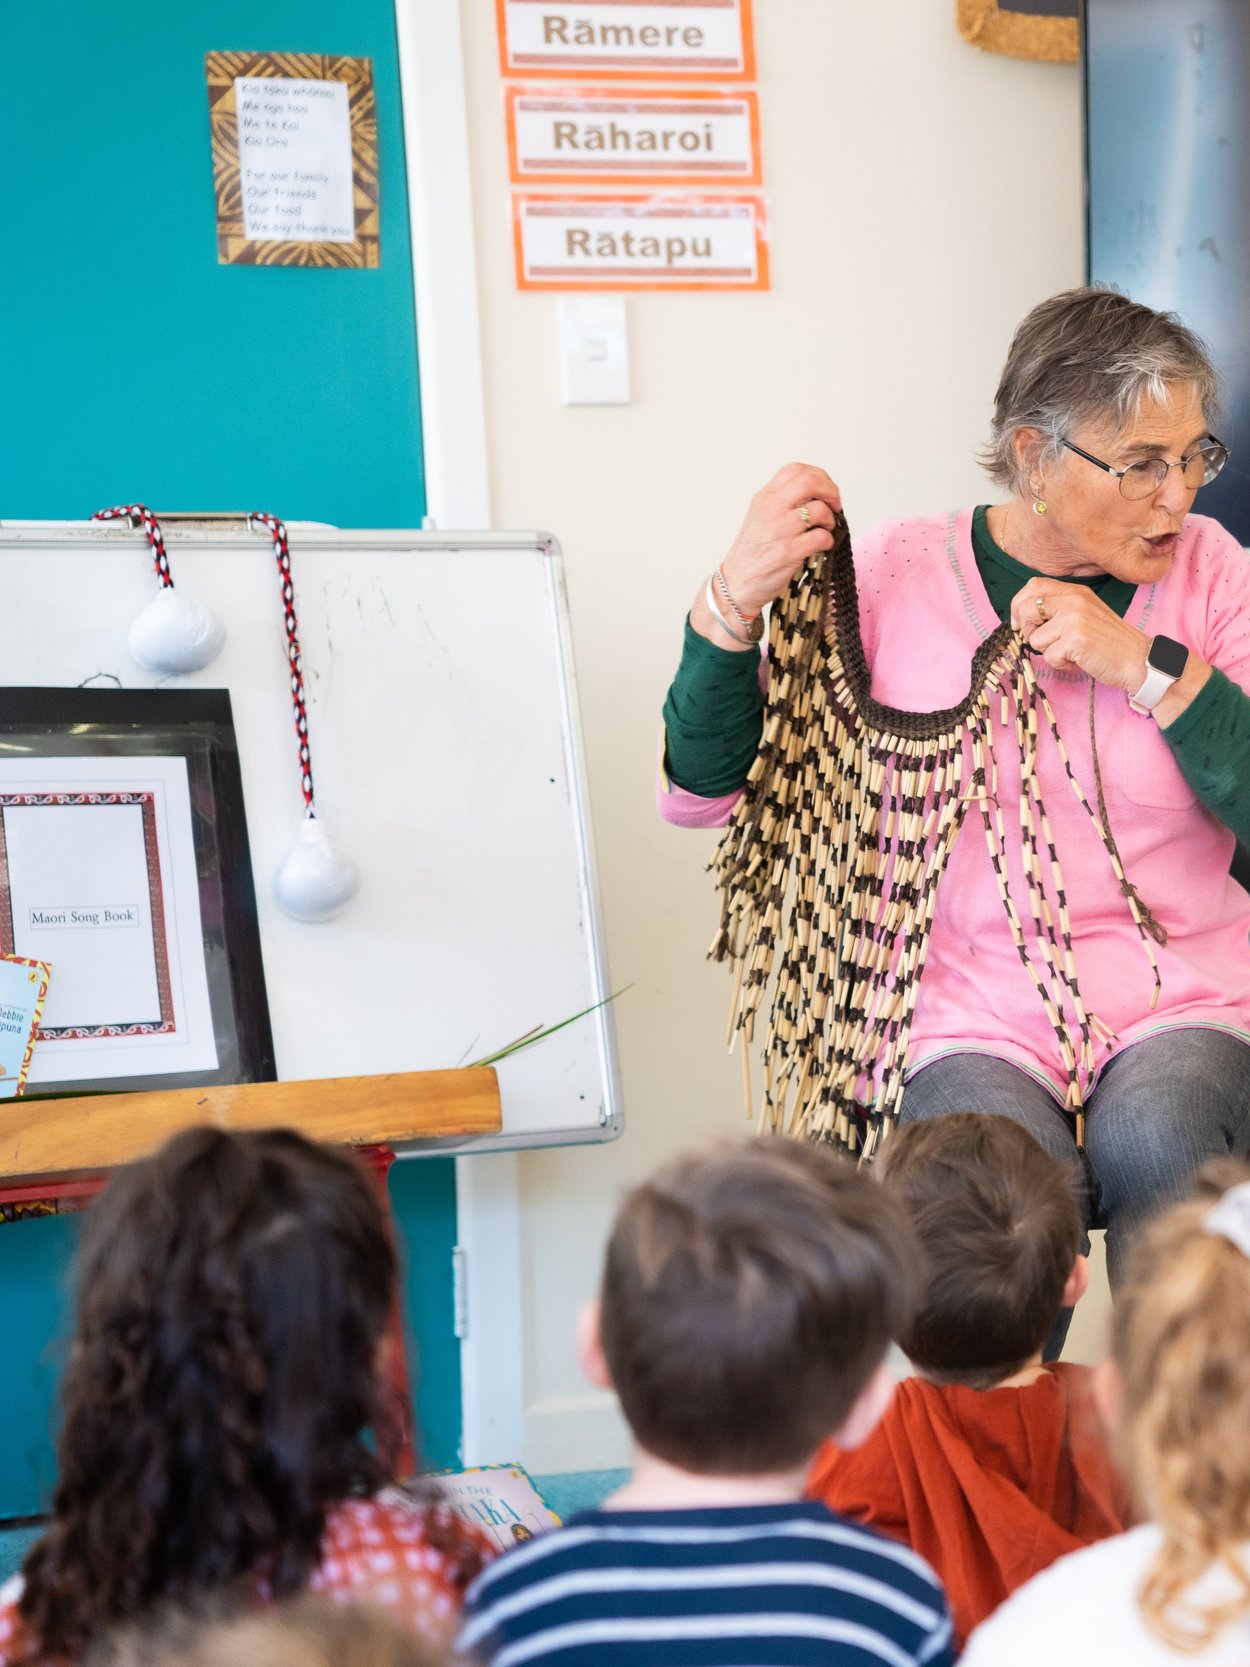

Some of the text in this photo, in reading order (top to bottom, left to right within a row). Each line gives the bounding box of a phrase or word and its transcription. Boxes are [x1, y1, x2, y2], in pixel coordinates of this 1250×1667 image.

[542, 14, 704, 48] Rāmere
[552, 120, 714, 152] Rāharoi
[565, 228, 713, 267] Rātapu
[32, 909, 134, 925] Maori Song Book
[467, 1486, 493, 1496] THE
